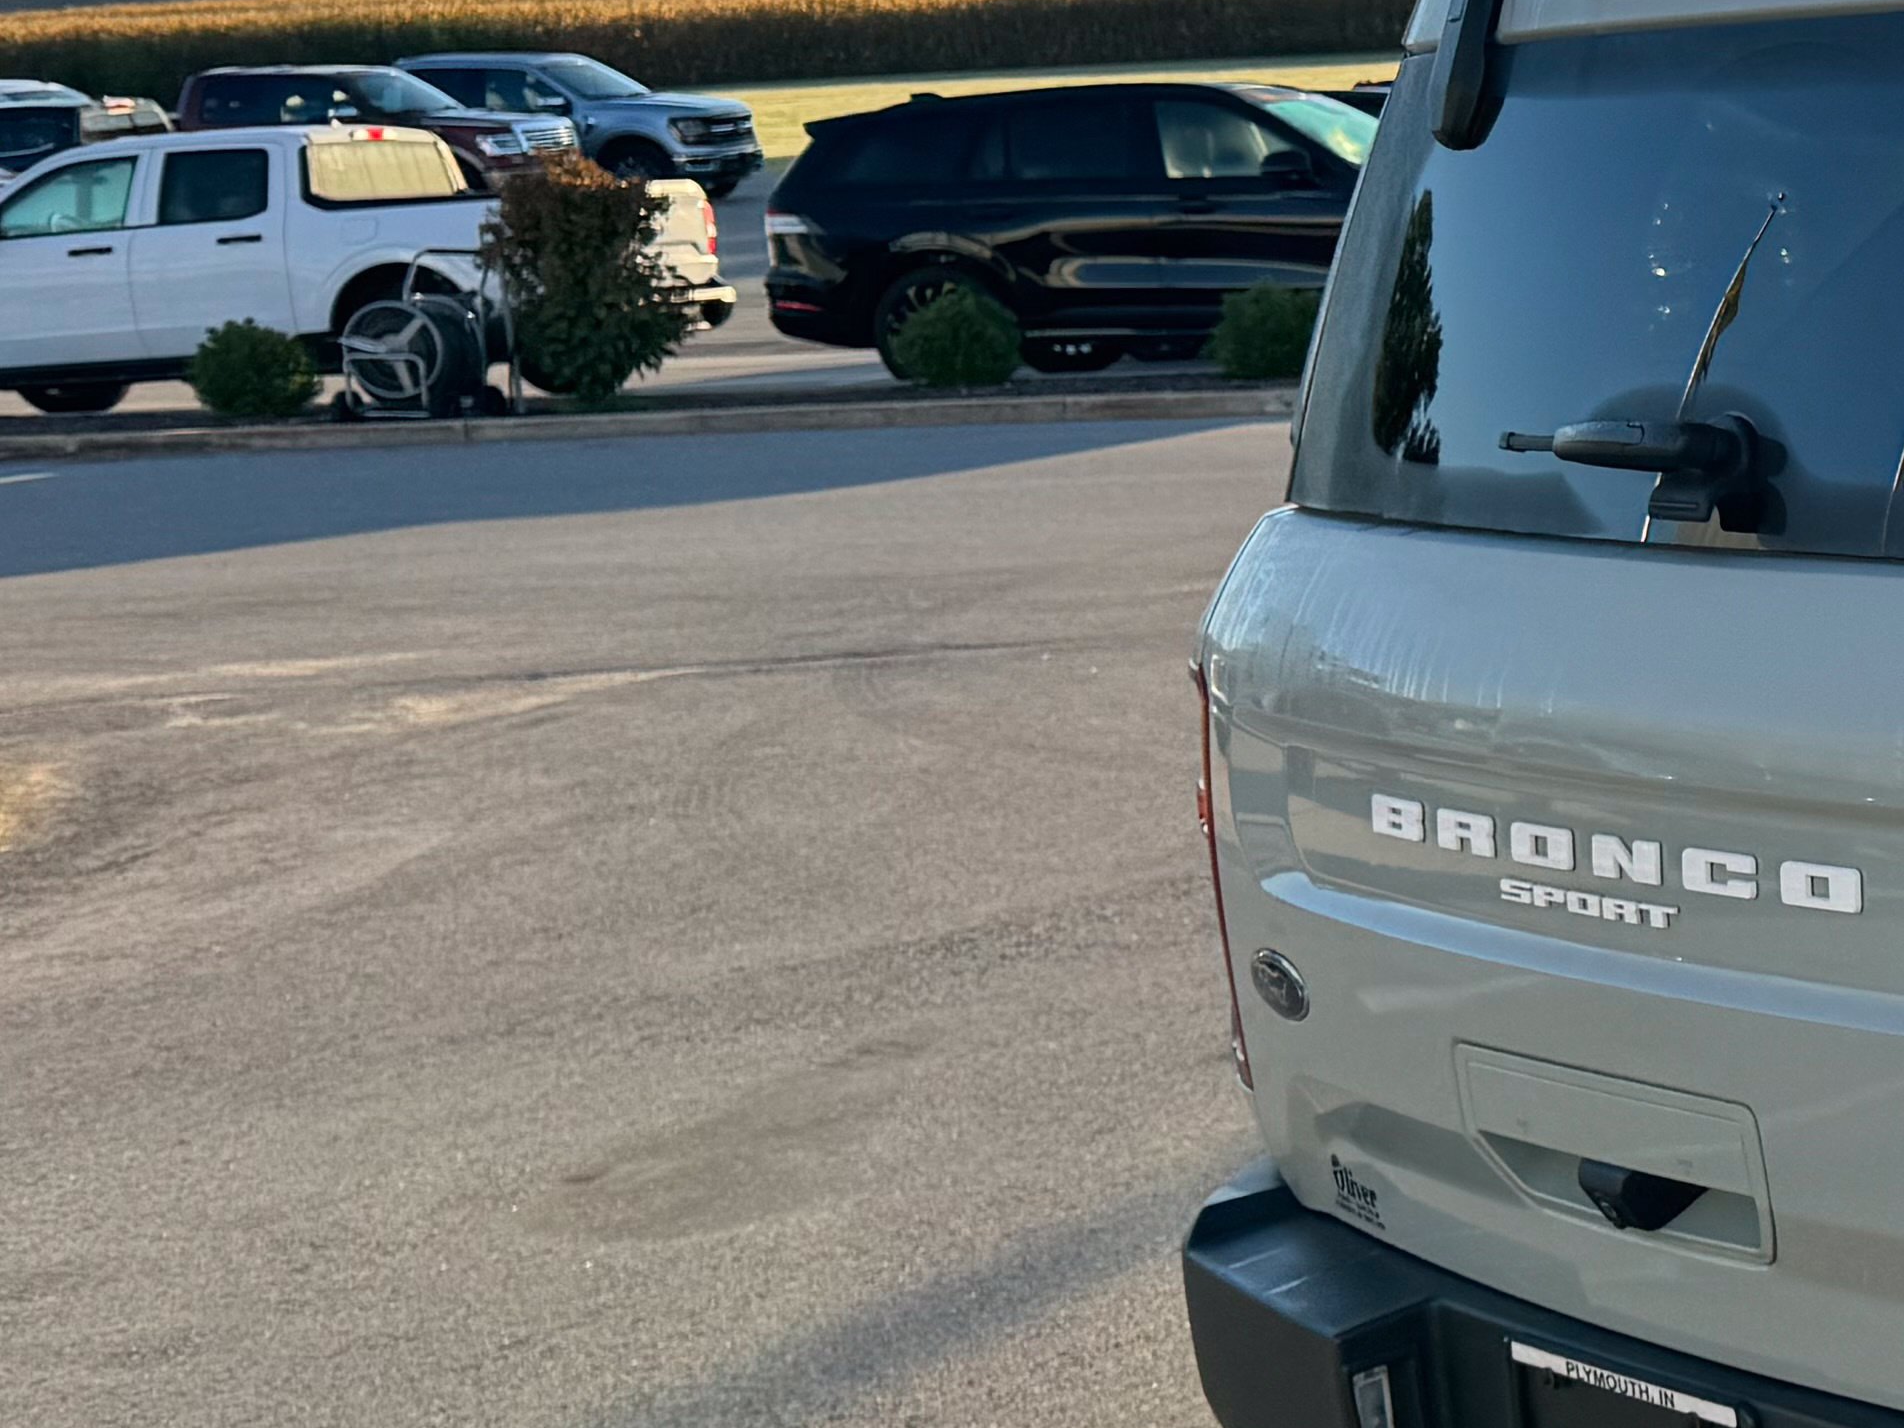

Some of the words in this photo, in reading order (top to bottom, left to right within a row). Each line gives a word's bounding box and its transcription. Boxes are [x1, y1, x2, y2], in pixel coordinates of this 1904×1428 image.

[1371, 793, 1864, 915] BRONCO
[1499, 877, 1680, 929] SPORT
[1658, 1390, 1676, 1409] IN
